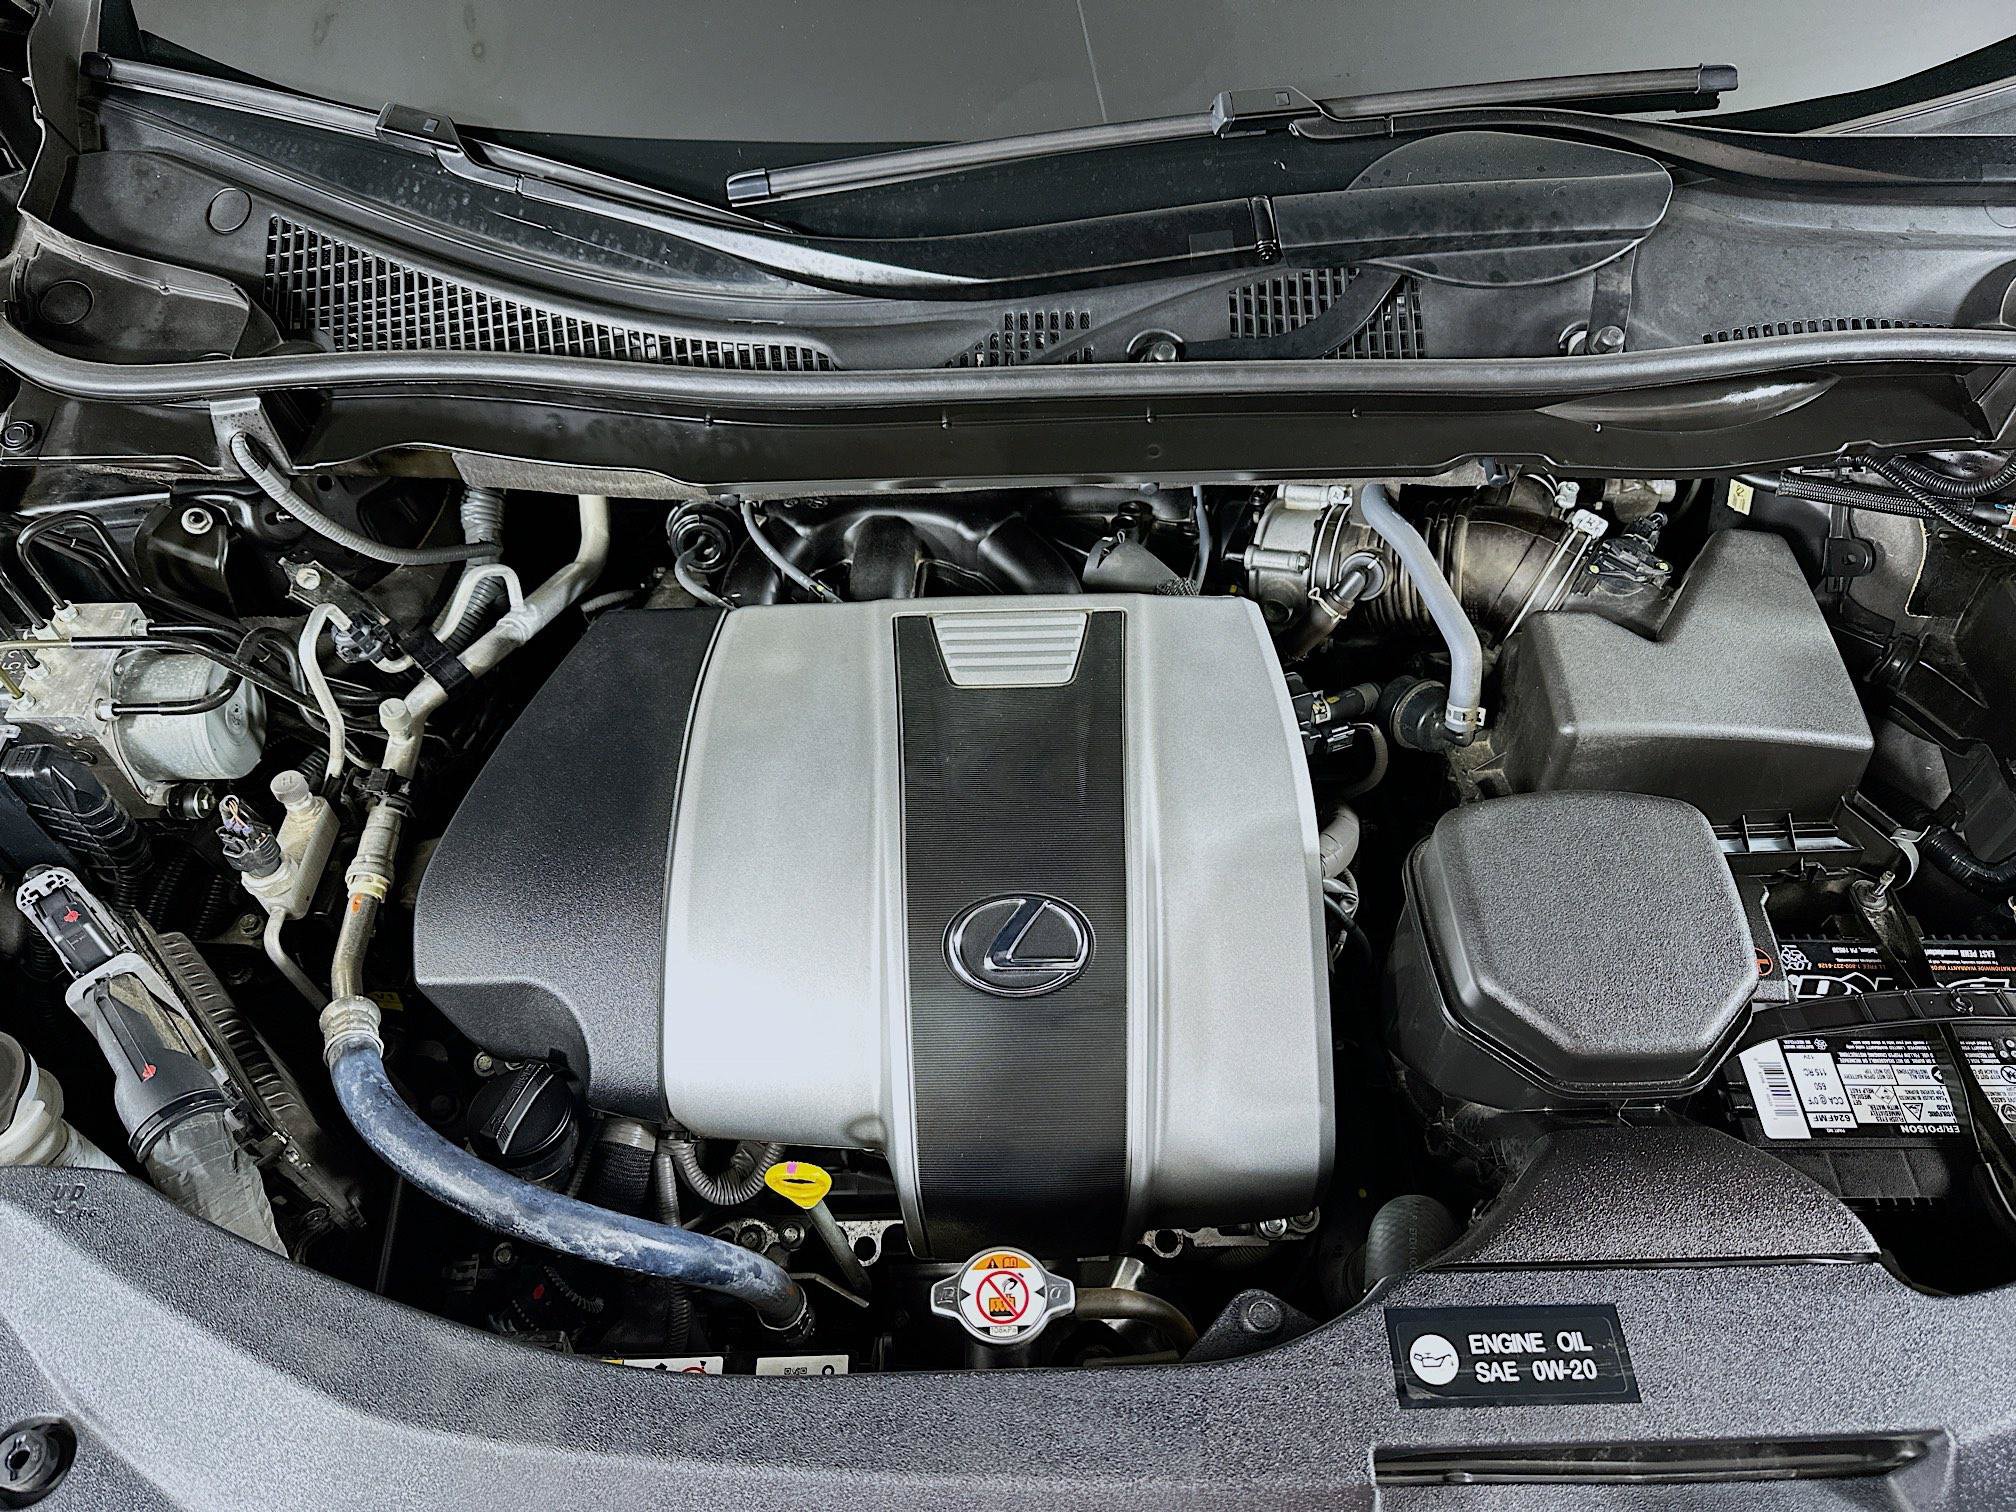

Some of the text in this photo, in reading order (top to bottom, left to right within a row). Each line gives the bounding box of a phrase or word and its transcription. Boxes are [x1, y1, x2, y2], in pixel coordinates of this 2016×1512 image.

[1819, 1095, 1828, 1105] @
[1828, 1097, 1845, 1105] CCA
[1468, 1331, 1594, 1355] ENGINE OIL
[1474, 1358, 1598, 1384] SAE 0W-20
